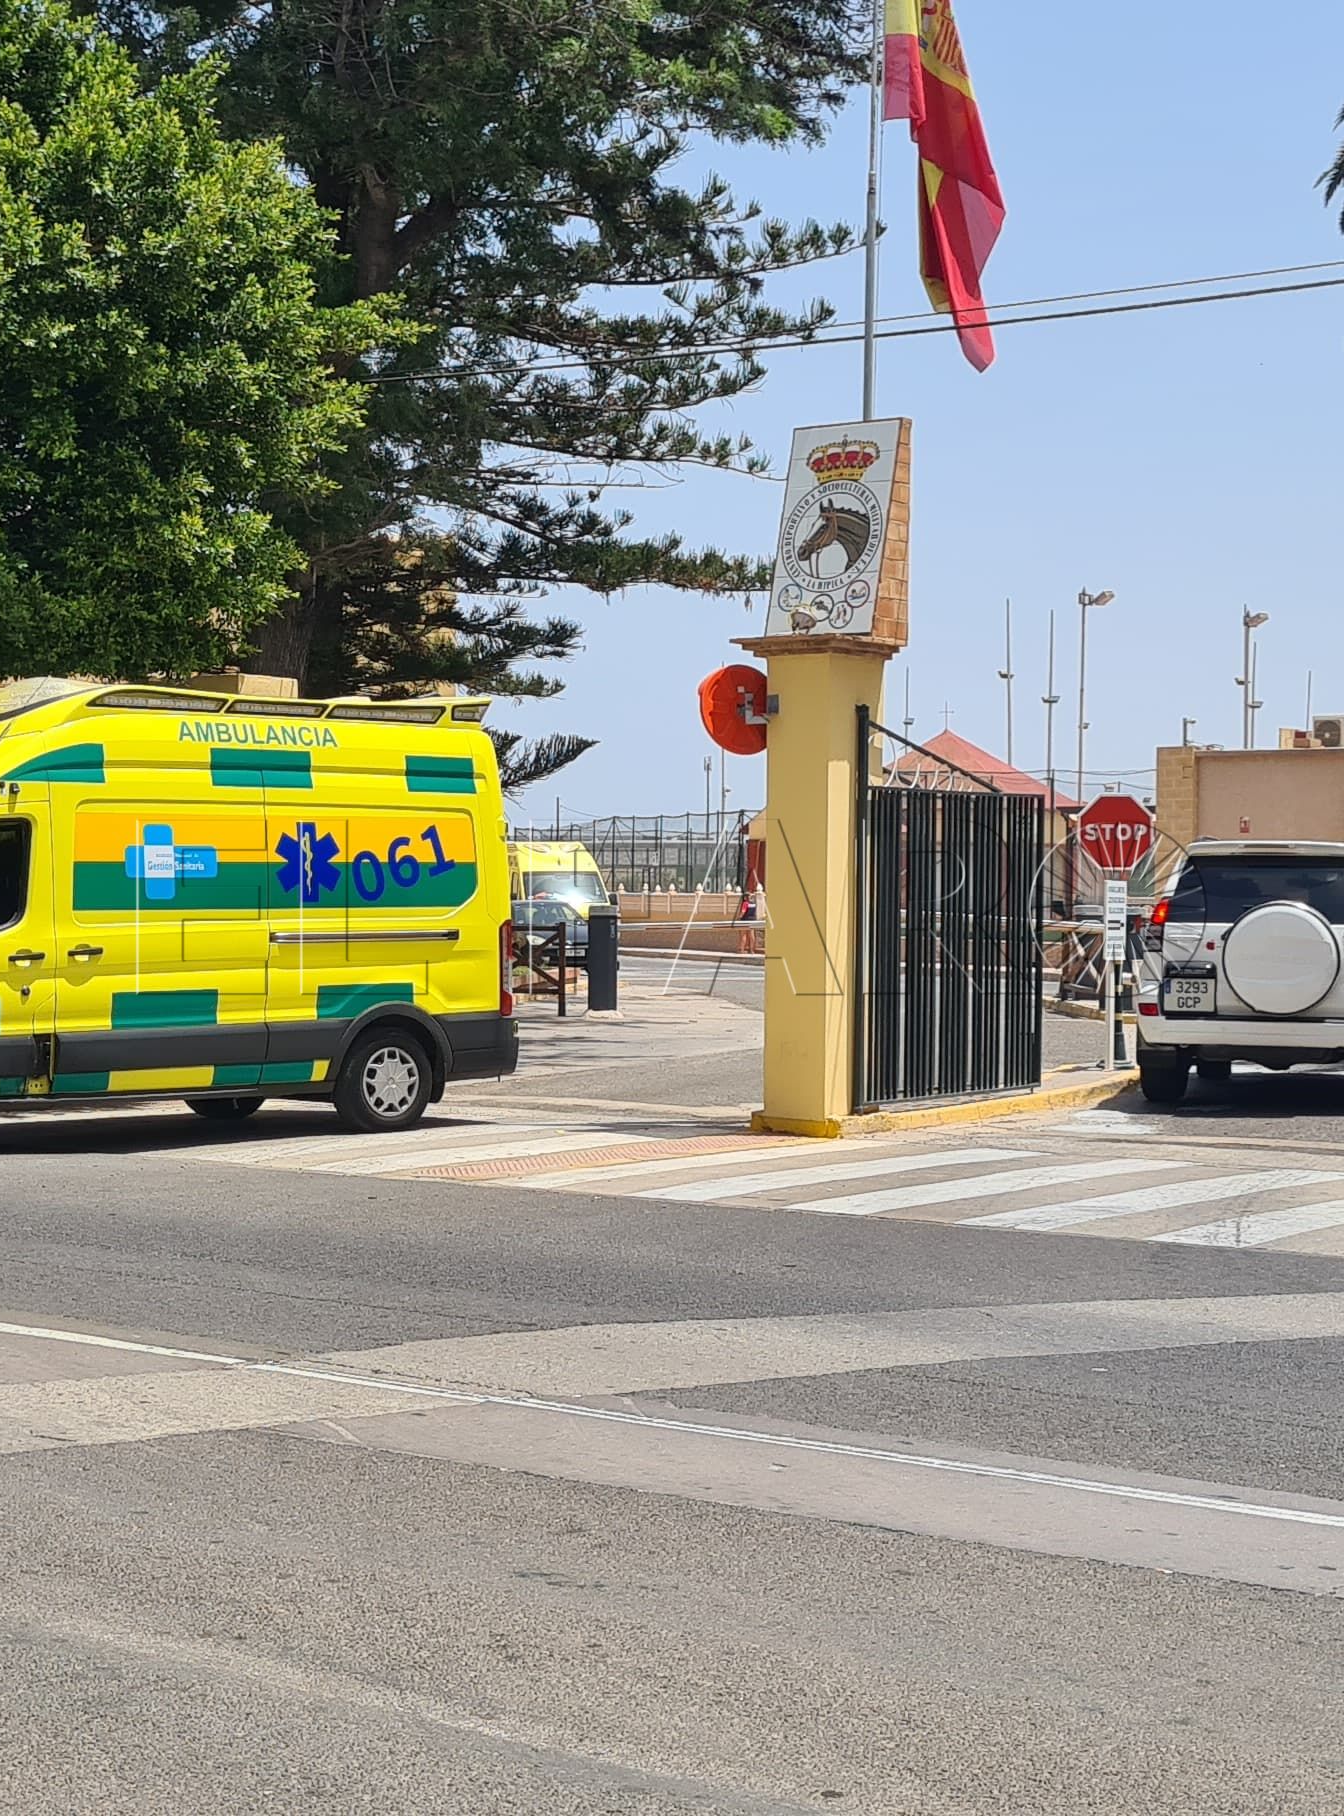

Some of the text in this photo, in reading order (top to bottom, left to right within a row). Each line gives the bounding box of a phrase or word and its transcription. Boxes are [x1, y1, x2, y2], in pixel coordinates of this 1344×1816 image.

[179, 721, 338, 748] AMBULANCIA
[1084, 823, 1147, 841] STOP
[351, 823, 456, 902] 061
[1175, 981, 1209, 994] 3293
[1176, 997, 1201, 1009] GCP
